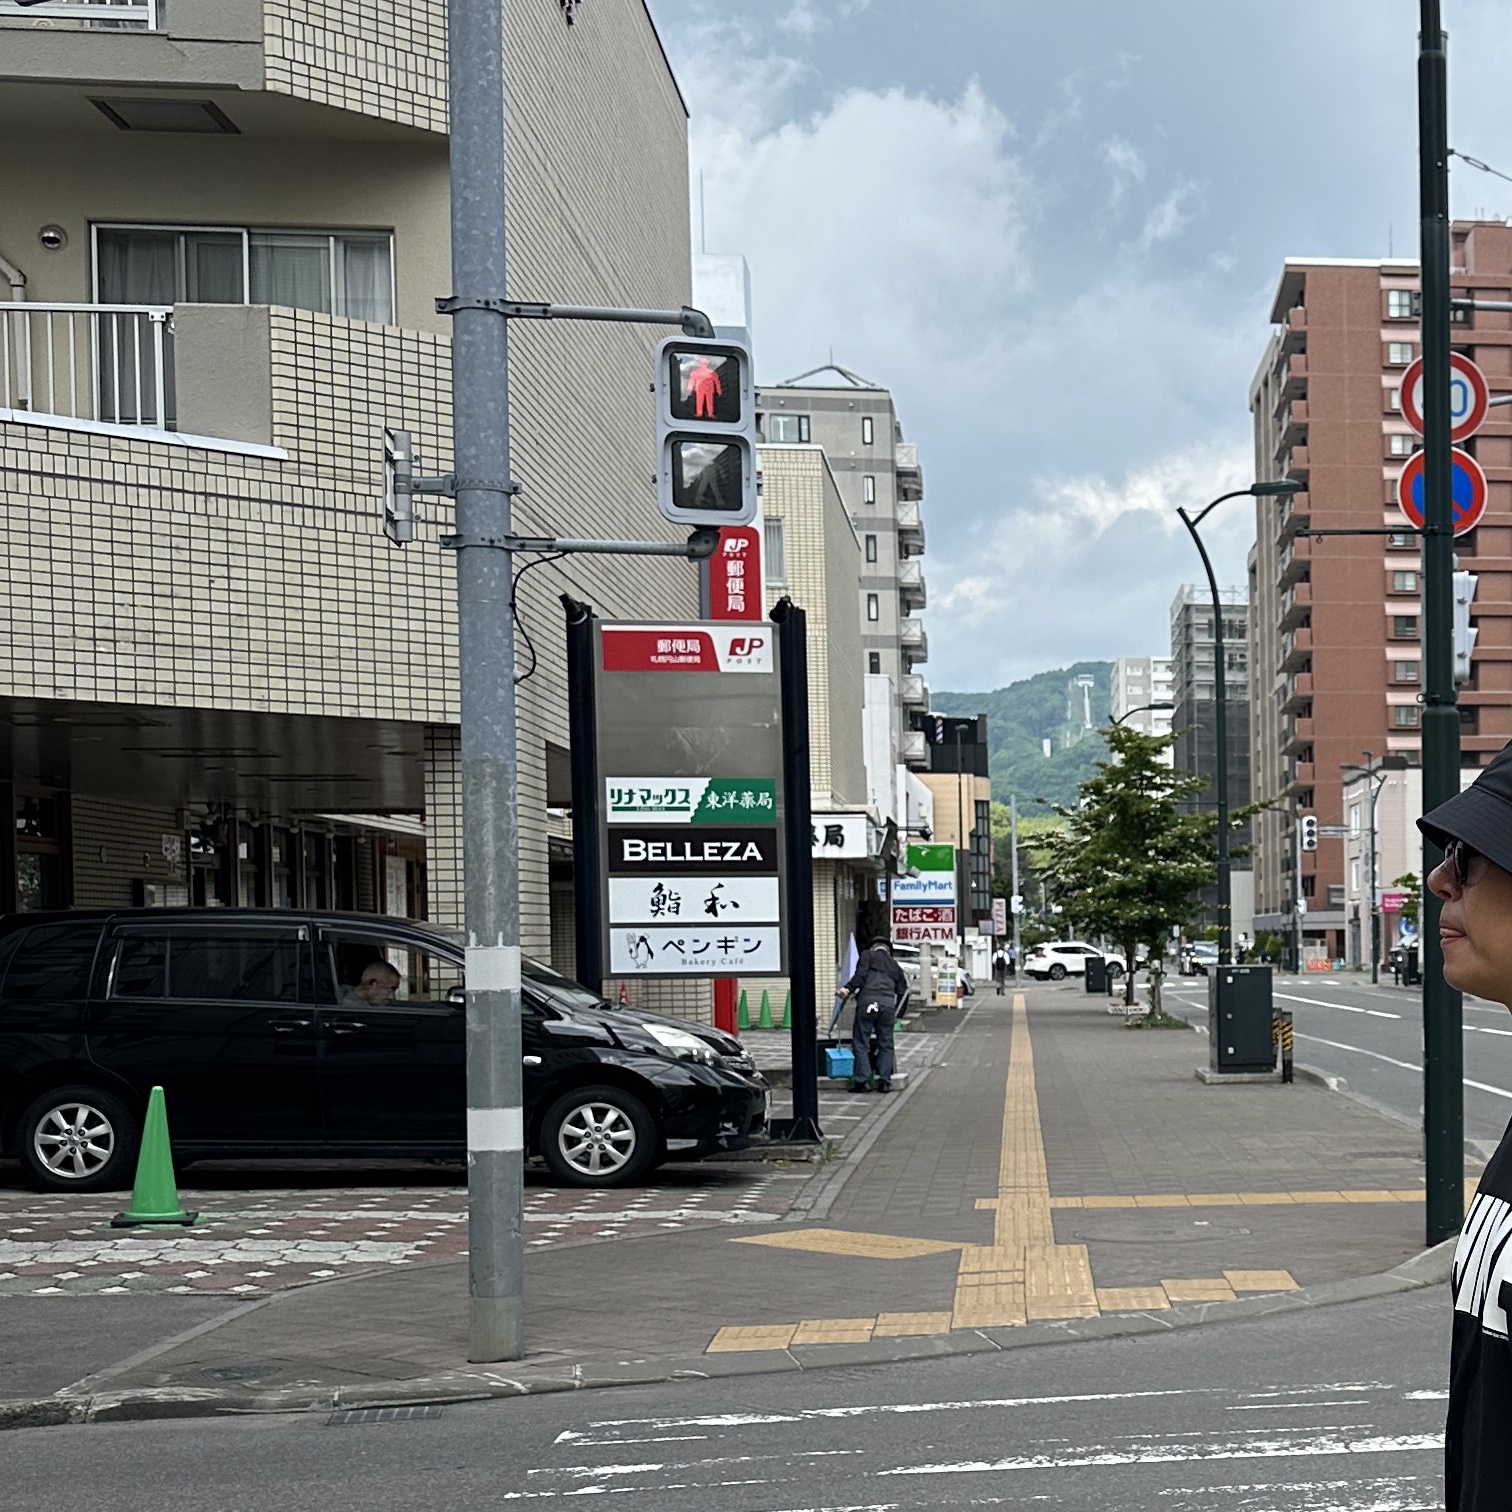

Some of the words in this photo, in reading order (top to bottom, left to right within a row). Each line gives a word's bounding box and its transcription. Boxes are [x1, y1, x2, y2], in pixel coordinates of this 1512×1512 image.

[726, 560, 745, 612] 郵便局
[656, 638, 701, 654] 郵便局
[728, 637, 764, 656] JP
[610, 788, 691, 806] リナマックス
[705, 790, 773, 810] 東洋薬局
[622, 838, 764, 862] BELLEZA
[893, 880, 953, 892] FamilyMart
[994, 901, 1004, 933] PIZZA
[896, 927, 954, 940] 銀行ATM
[662, 935, 762, 955] ペンギン
[681, 957, 717, 967] Bakery
[720, 957, 744, 966] Café
